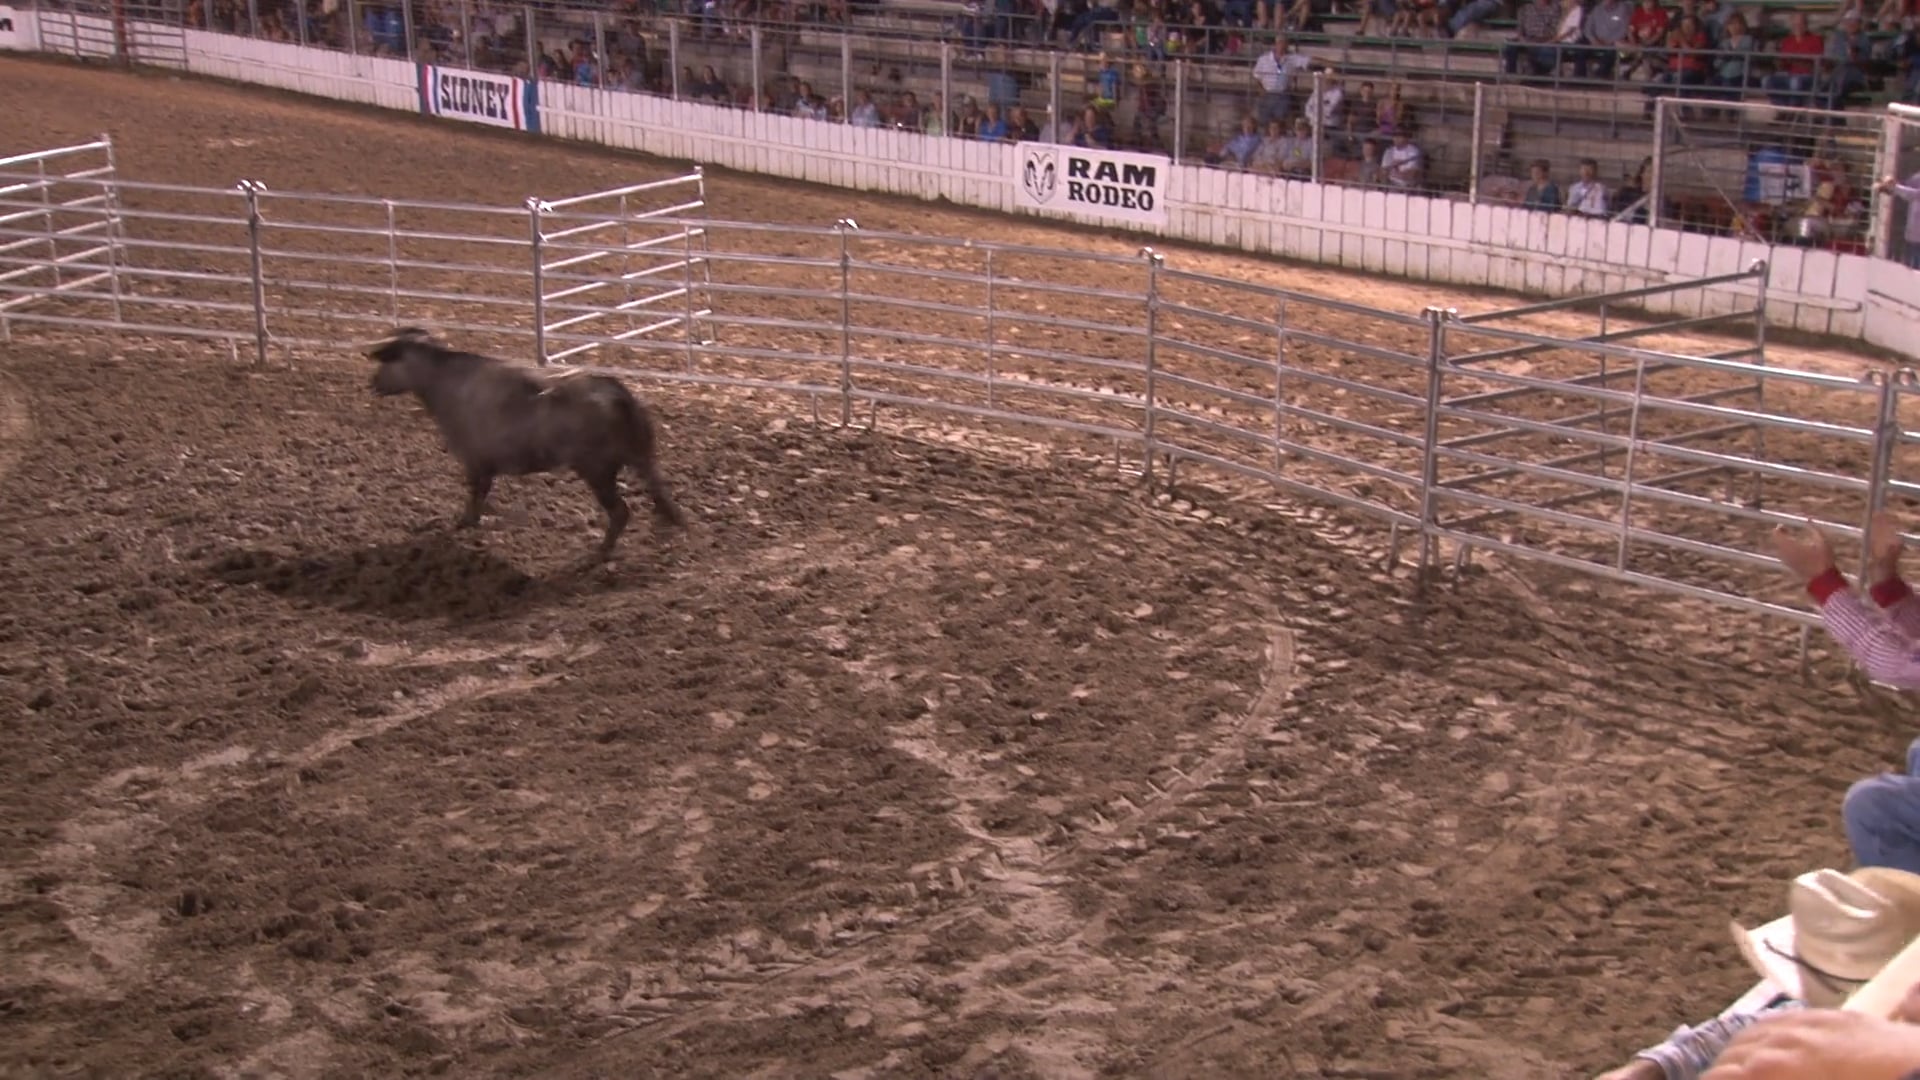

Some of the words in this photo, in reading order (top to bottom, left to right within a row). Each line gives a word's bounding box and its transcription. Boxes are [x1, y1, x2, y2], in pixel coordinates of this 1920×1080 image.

[441, 74, 510, 120] SIDNEY
[1068, 157, 1156, 188] RAM
[1067, 180, 1154, 212] RODEO
